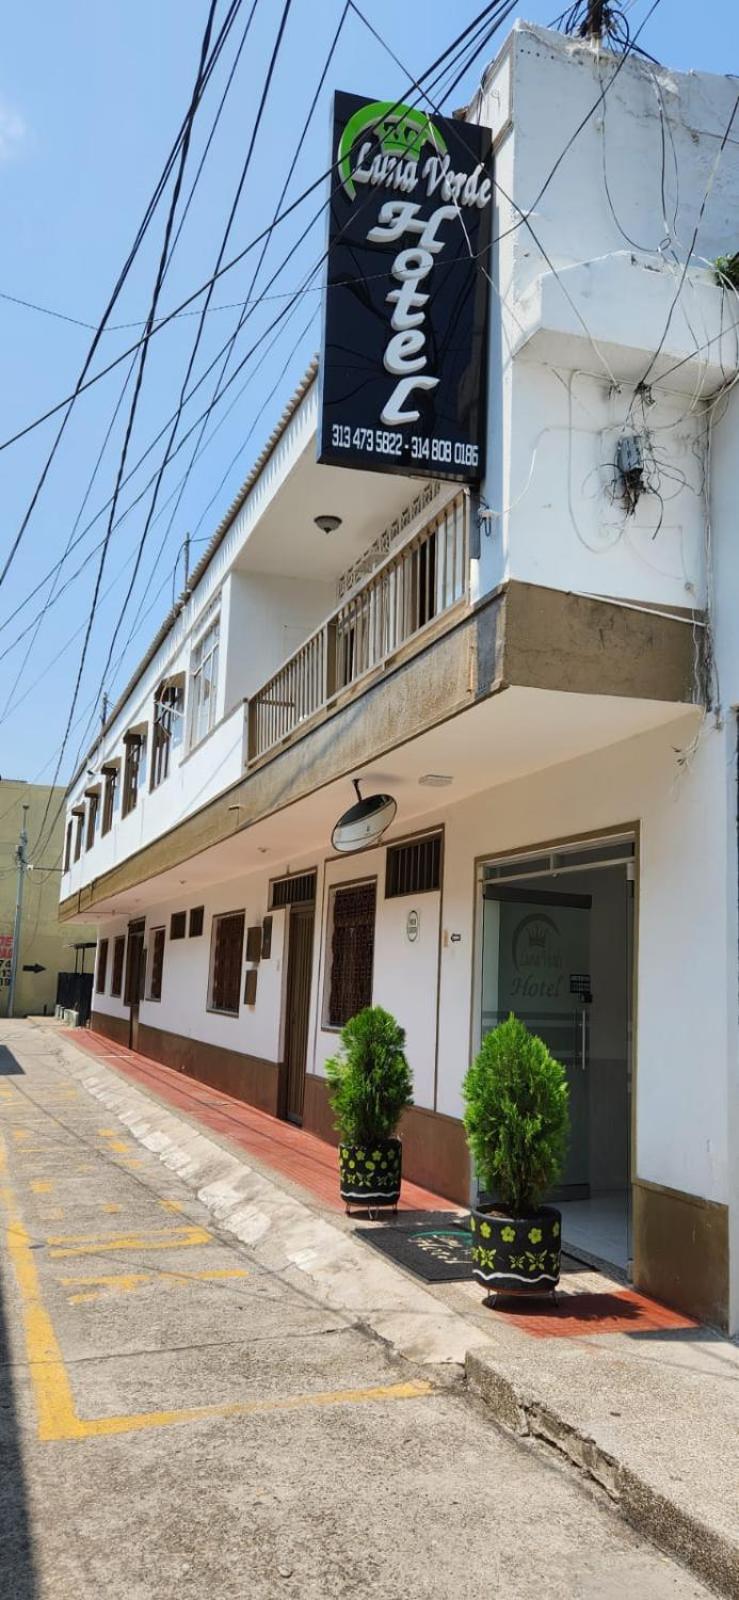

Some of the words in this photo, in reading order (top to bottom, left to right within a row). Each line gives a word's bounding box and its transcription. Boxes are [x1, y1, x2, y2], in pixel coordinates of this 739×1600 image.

[350, 142, 419, 194] Luna
[421, 154, 492, 209] Verde
[332, 424, 350, 448] 313
[353, 427, 374, 451] 473
[375, 431, 402, 455] 5822
[411, 436, 430, 459] 314
[431, 439, 452, 462] 808
[454, 442, 479, 466] 0186
[509, 973, 564, 998] Hotel
